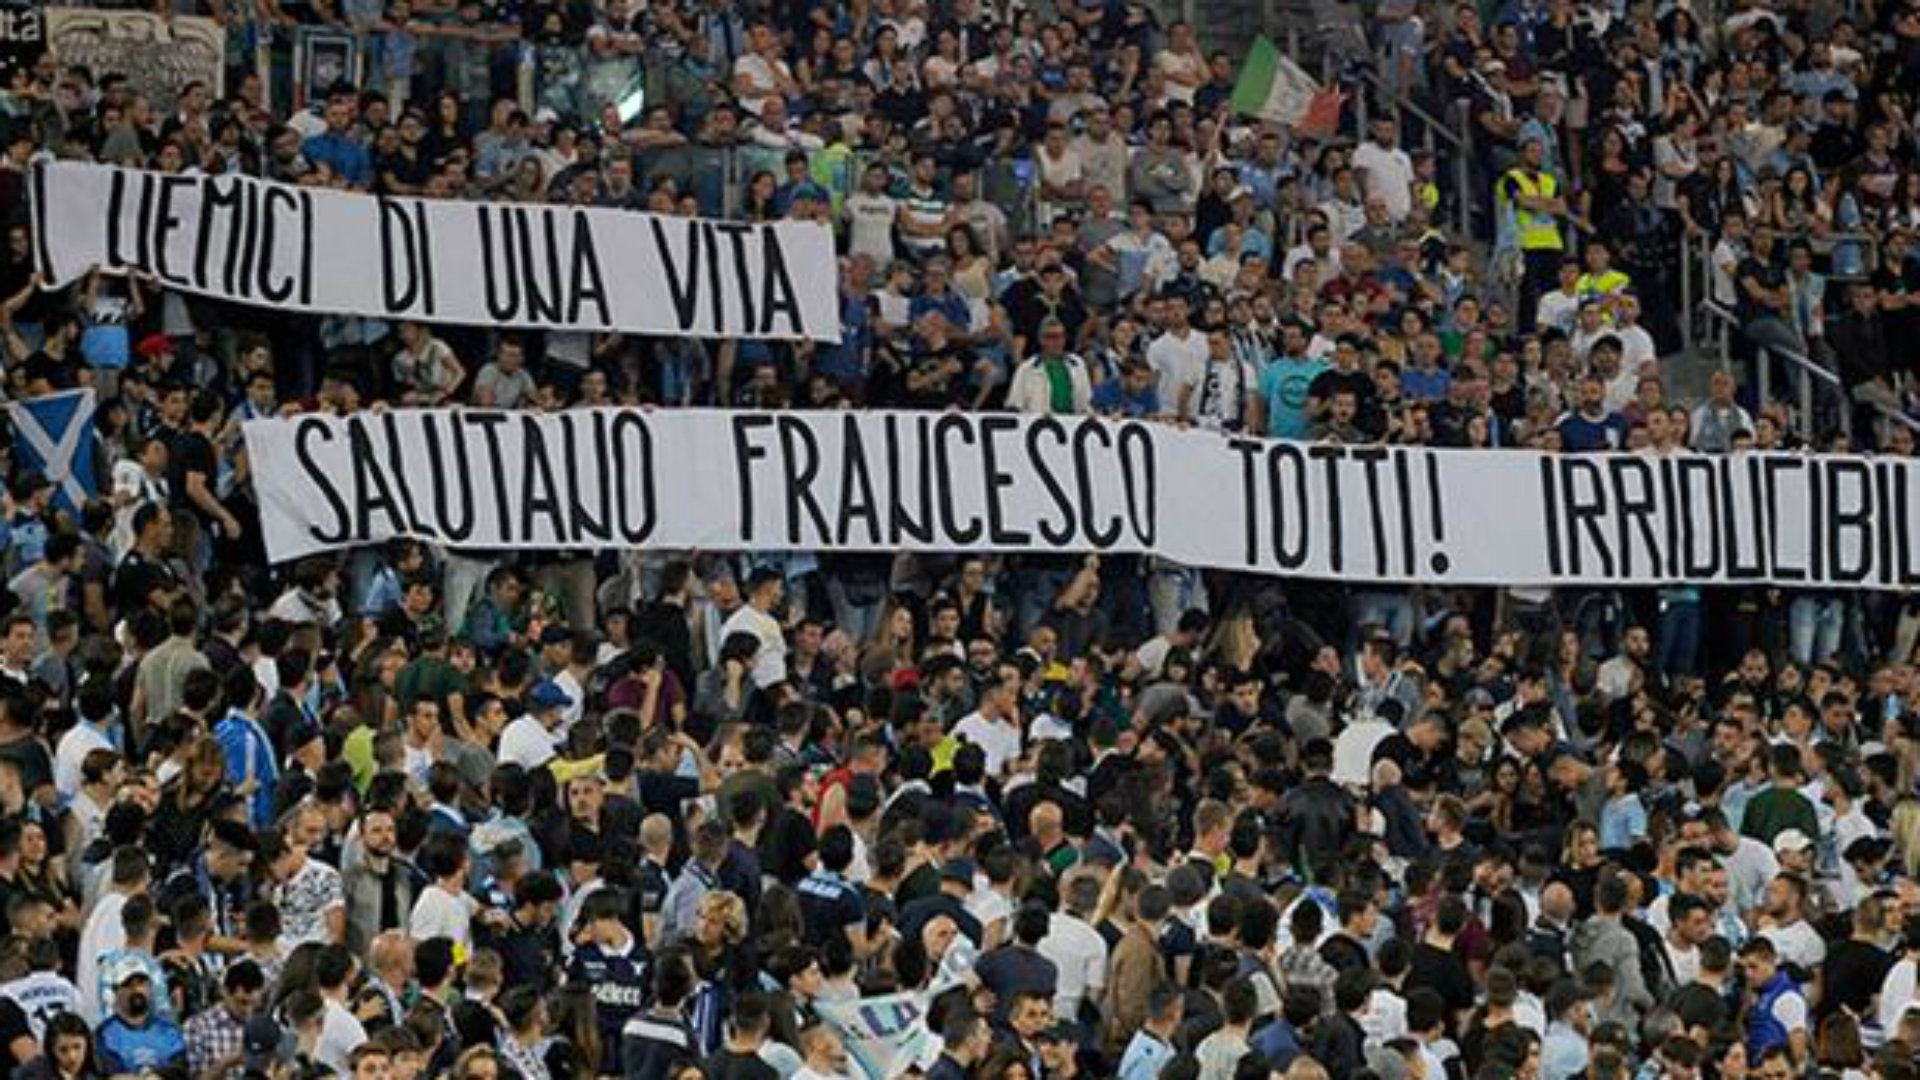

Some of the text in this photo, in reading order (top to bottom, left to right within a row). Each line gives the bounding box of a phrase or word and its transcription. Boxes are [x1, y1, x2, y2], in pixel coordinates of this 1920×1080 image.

[374, 192, 435, 316] DI
[478, 205, 611, 326] UNA
[649, 217, 804, 335] VITA
[294, 411, 657, 546] SALUTANO
[732, 413, 1156, 549] FRANCESCO
[1228, 439, 1451, 576] TOTTI!
